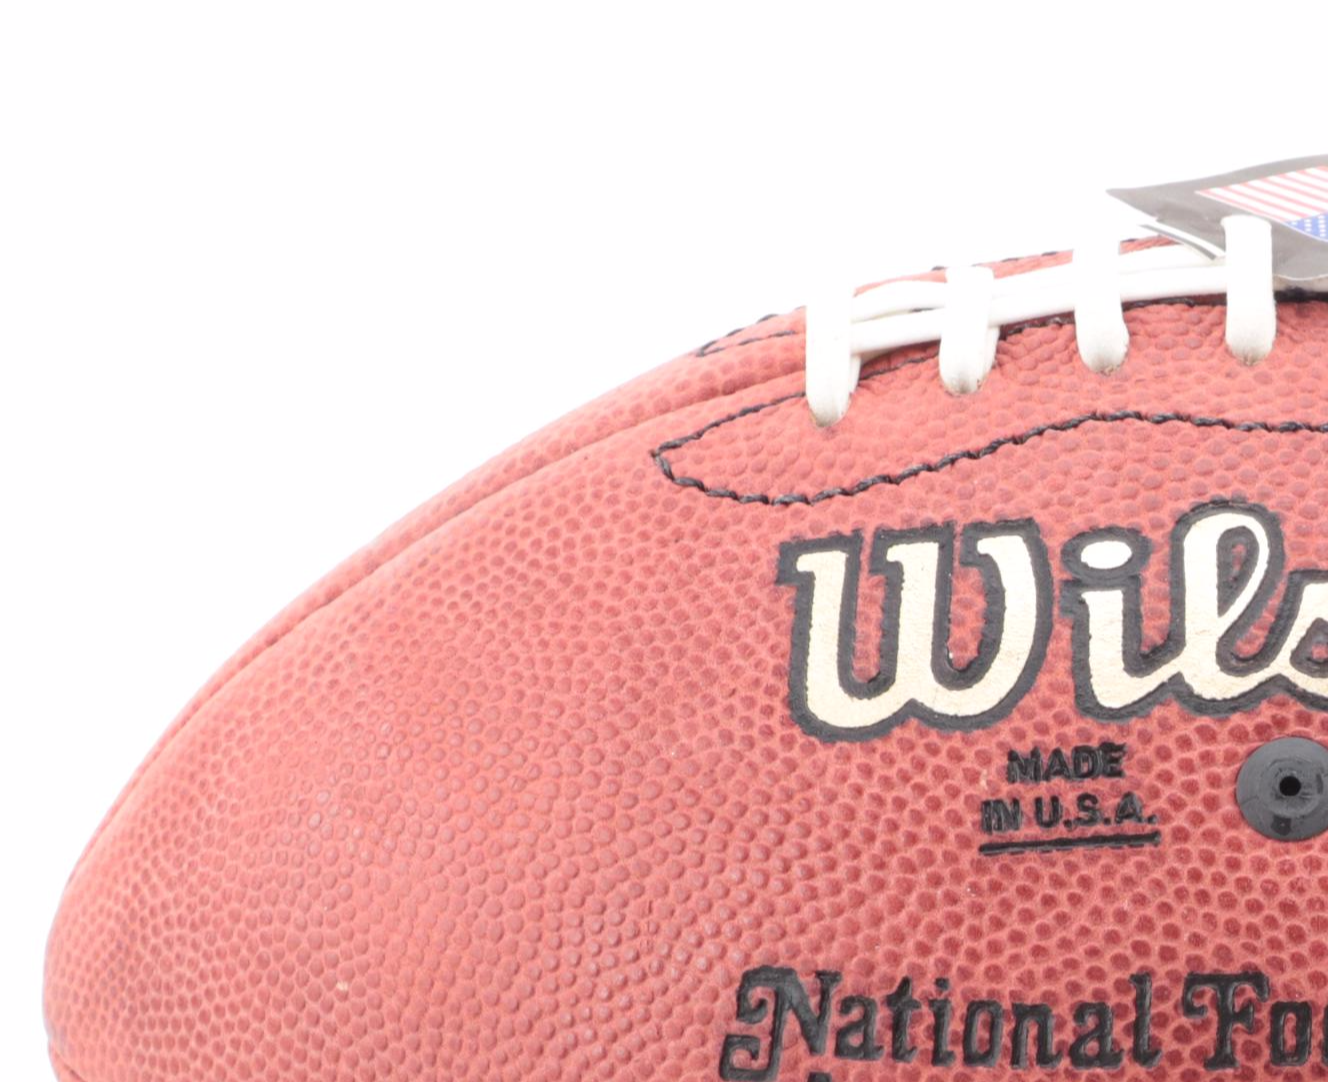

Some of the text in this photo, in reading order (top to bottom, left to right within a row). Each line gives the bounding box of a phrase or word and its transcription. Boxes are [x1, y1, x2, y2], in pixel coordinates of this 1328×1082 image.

[1006, 741, 1128, 785] MADE
[980, 792, 1158, 833] IN U.S.A.
